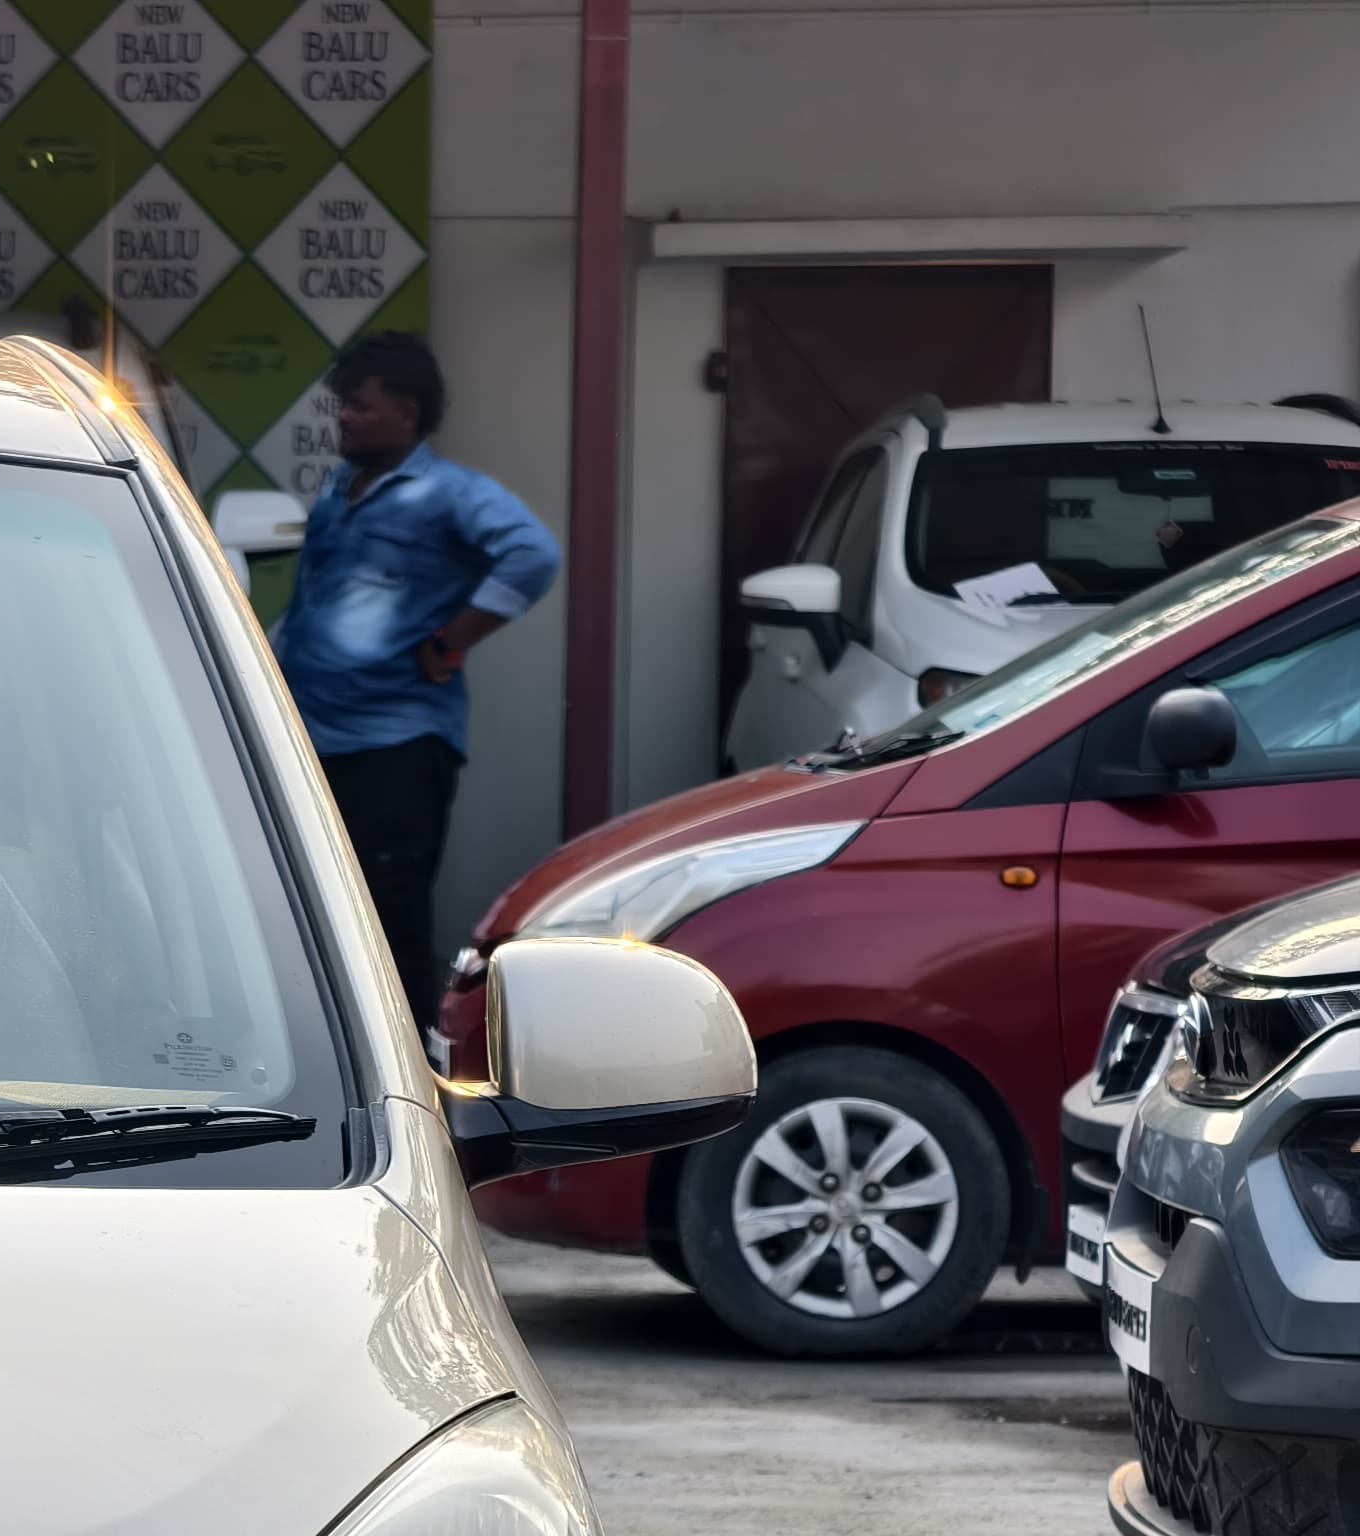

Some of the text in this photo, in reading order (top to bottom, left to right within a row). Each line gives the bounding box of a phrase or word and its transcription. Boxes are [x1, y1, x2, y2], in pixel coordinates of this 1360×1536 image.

[138, 5, 185, 25] NEW
[321, 4, 369, 24] NEW
[117, 33, 203, 64] BALU
[302, 32, 389, 63] BALU
[117, 72, 202, 102] CARS
[303, 71, 387, 101] CARS
[133, 202, 181, 221] NEW
[318, 201, 368, 221] NEW
[114, 229, 200, 260] BALU
[298, 229, 386, 259] BALU
[114, 268, 199, 298] CARS
[300, 268, 384, 297] CARS
[312, 396, 341, 416] NE
[292, 424, 339, 455] BA
